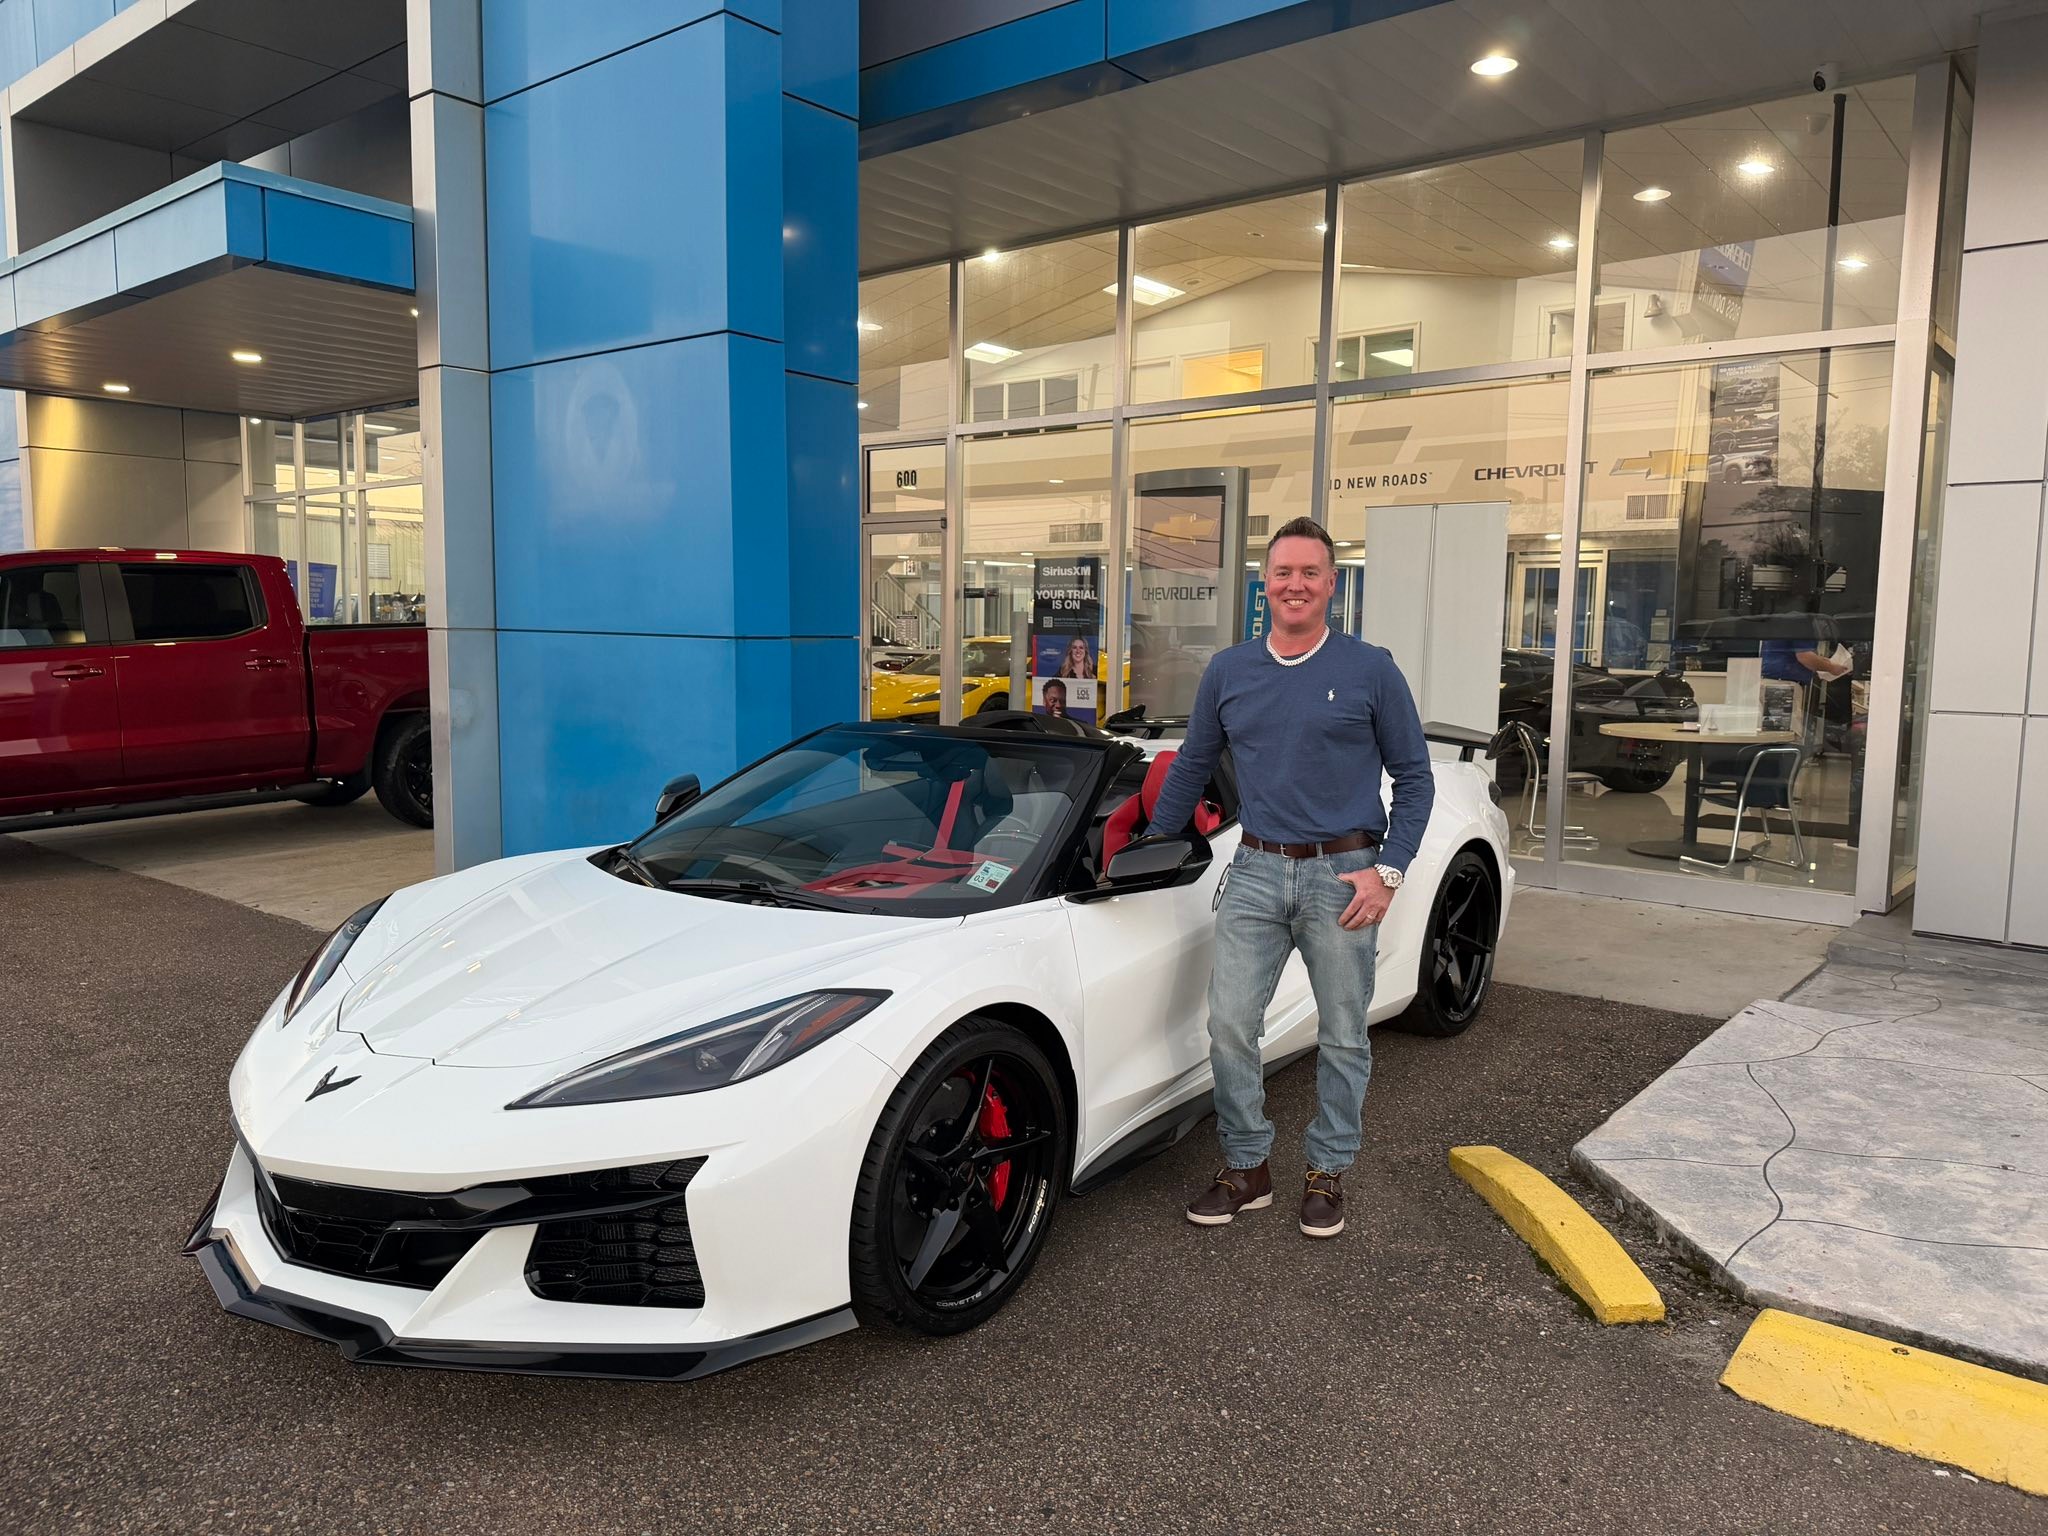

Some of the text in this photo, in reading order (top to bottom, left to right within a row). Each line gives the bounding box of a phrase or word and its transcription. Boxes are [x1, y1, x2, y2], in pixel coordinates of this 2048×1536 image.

[1474, 461, 1598, 481] CHEVROLT
[896, 469, 917, 488] 600
[1347, 476, 1377, 489] NEW
[1042, 566, 1091, 576] SiriusXM
[1036, 589, 1098, 600] YOUR TRIAL
[1141, 586, 1216, 601] CHEVROLET
[1052, 600, 1081, 610] IS ON
[1252, 587, 1266, 639] OLET
[973, 875, 985, 883] 03
[936, 1290, 982, 1307] CORVETTE
